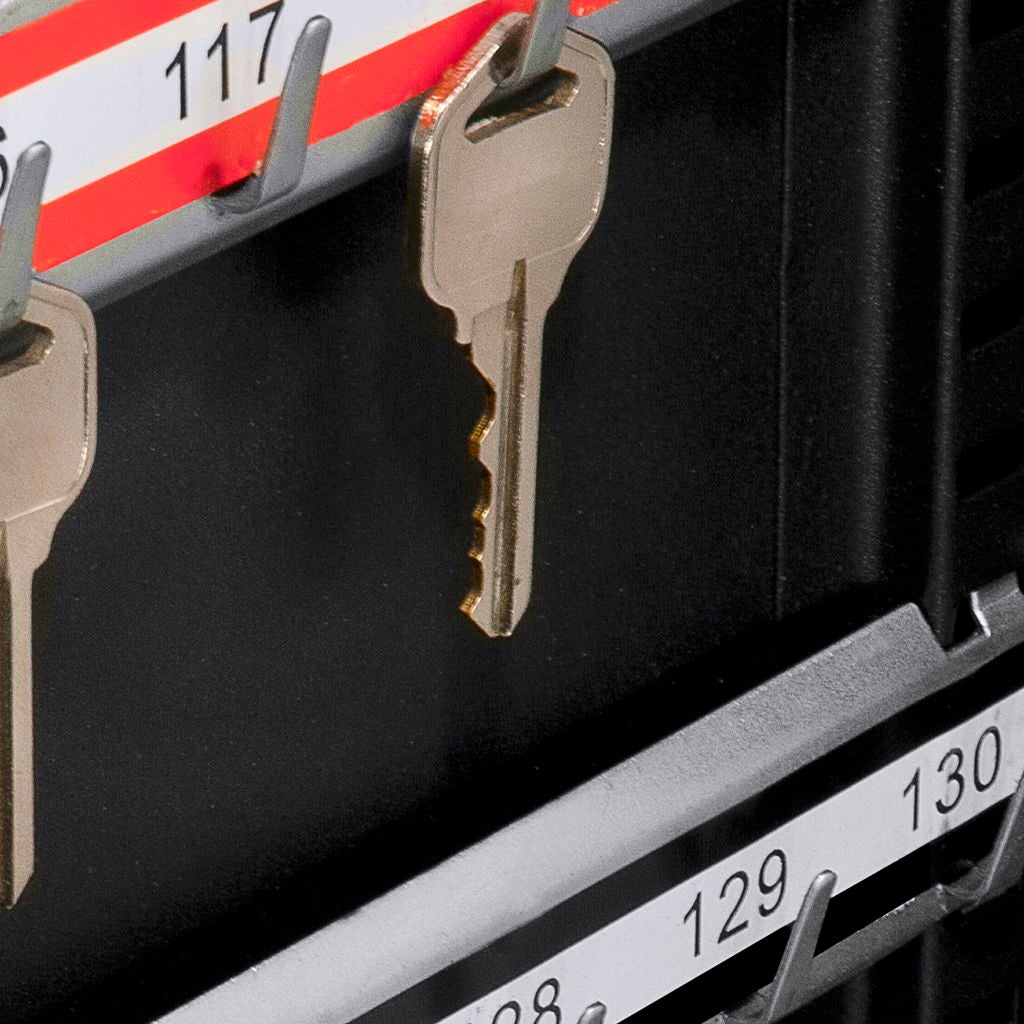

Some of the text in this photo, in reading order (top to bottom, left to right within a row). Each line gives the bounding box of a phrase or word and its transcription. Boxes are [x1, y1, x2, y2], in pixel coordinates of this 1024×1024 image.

[165, 0, 285, 120] 117
[683, 848, 787, 958] 129
[903, 725, 1001, 832] 130
